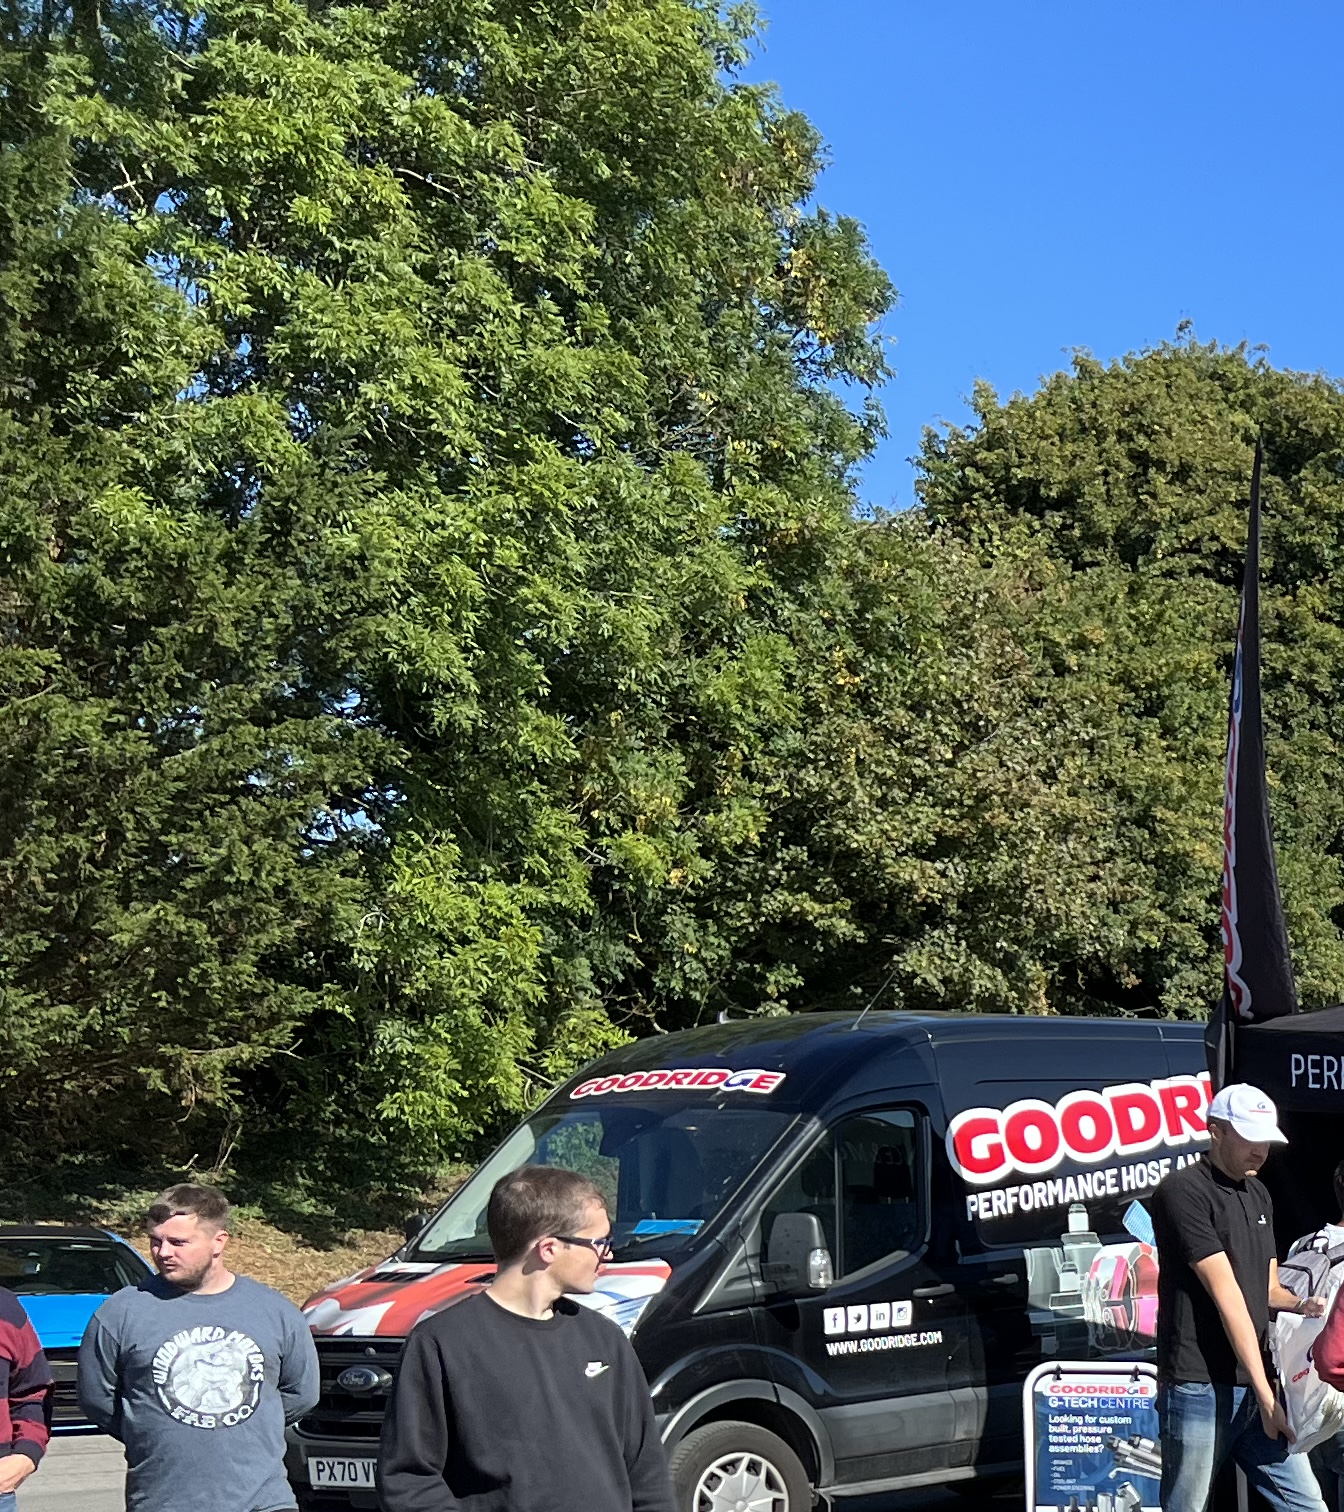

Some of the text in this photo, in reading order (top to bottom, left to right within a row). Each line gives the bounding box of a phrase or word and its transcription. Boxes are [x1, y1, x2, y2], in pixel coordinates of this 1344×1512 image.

[572, 1071, 781, 1097] GOODRIDGE
[966, 1167, 1120, 1221] PERFORMANCE
[825, 1331, 943, 1356] WWW.GOODRIDGE.COM
[152, 1326, 265, 1384] WOODWARD MOTORS
[1049, 1385, 1149, 1395] GOODRIDGE
[1048, 1397, 1150, 1409] G-TECH CENTRE
[171, 1405, 216, 1429] FAB
[1048, 1414, 1132, 1425] Looking for custom
[1072, 1425, 1113, 1435] pressure
[1048, 1434, 1102, 1444] tested hose
[1048, 1444, 1105, 1453] assemblies?
[316, 1460, 358, 1482] PX70
